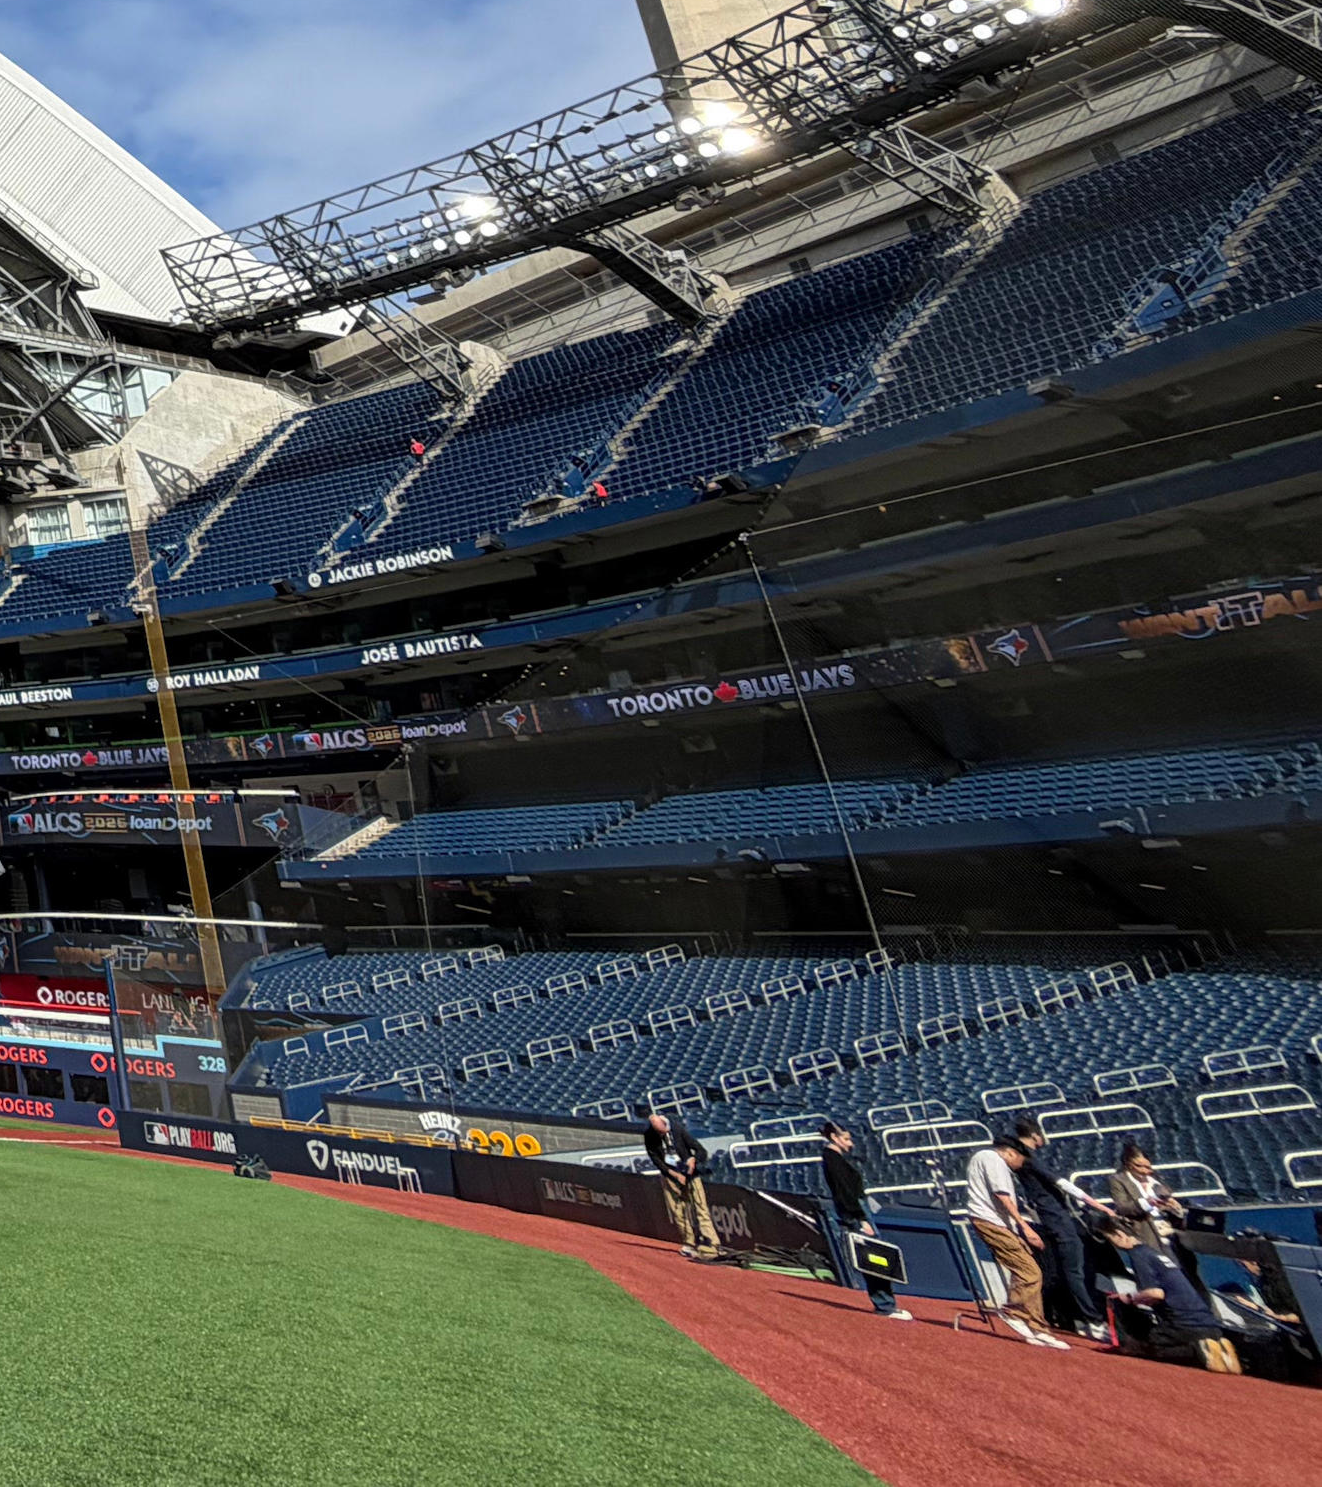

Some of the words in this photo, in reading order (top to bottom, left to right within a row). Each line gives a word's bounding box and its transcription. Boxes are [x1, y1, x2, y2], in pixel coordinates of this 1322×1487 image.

[328, 562, 376, 584] JACKIE
[376, 545, 455, 573] ROBINSON
[1207, 591, 1265, 632] IT
[362, 642, 399, 665] JOSÉ
[405, 633, 485, 658] BAUTISTA
[166, 674, 192, 690] ROY
[194, 665, 261, 687] HALLADAY
[607, 685, 714, 718] TORONTO
[737, 673, 795, 701] BLUE
[797, 664, 856, 693] JAYS
[21, 687, 73, 705] BEESTON
[321, 729, 367, 750] ALCS
[402, 719, 467, 740] loanDepot
[11, 752, 81, 770] TORONTO
[97, 749, 133, 766] BLUE
[136, 746, 170, 764] JAYS
[34, 812, 82, 833] ALCS
[130, 815, 213, 834] loanDepot
[197, 1054, 227, 1074] 328
[418, 1111, 462, 1136] HEINZ
[169, 1124, 237, 1154] PLAYBALL.ORG
[331, 1148, 401, 1176] FANDUEL
